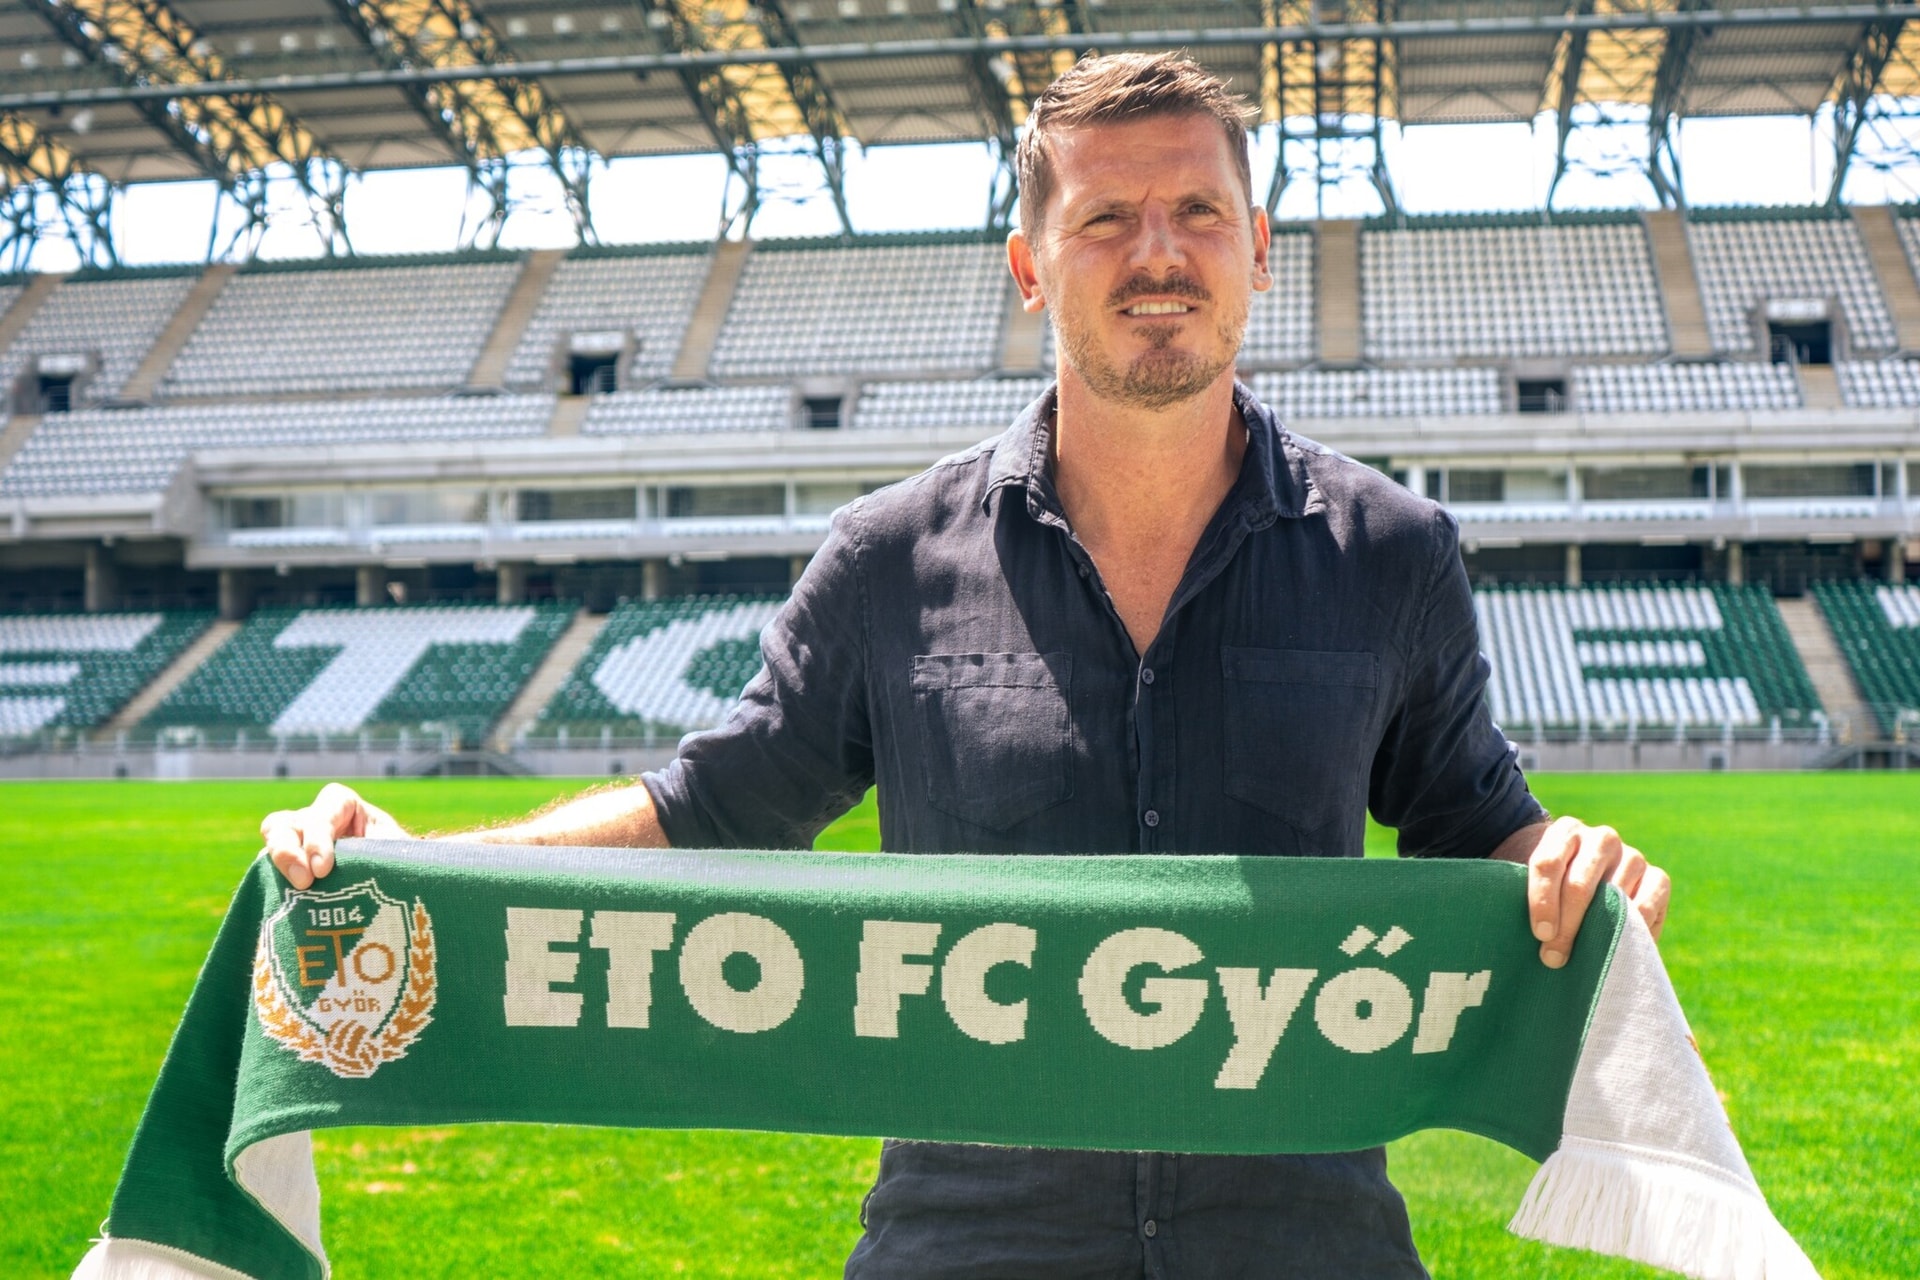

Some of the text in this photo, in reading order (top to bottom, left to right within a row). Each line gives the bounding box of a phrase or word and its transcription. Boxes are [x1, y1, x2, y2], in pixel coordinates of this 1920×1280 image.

[308, 906, 365, 927] 1904
[297, 927, 396, 987] ETO
[504, 907, 804, 1033] ETO
[854, 920, 1037, 1045] FC
